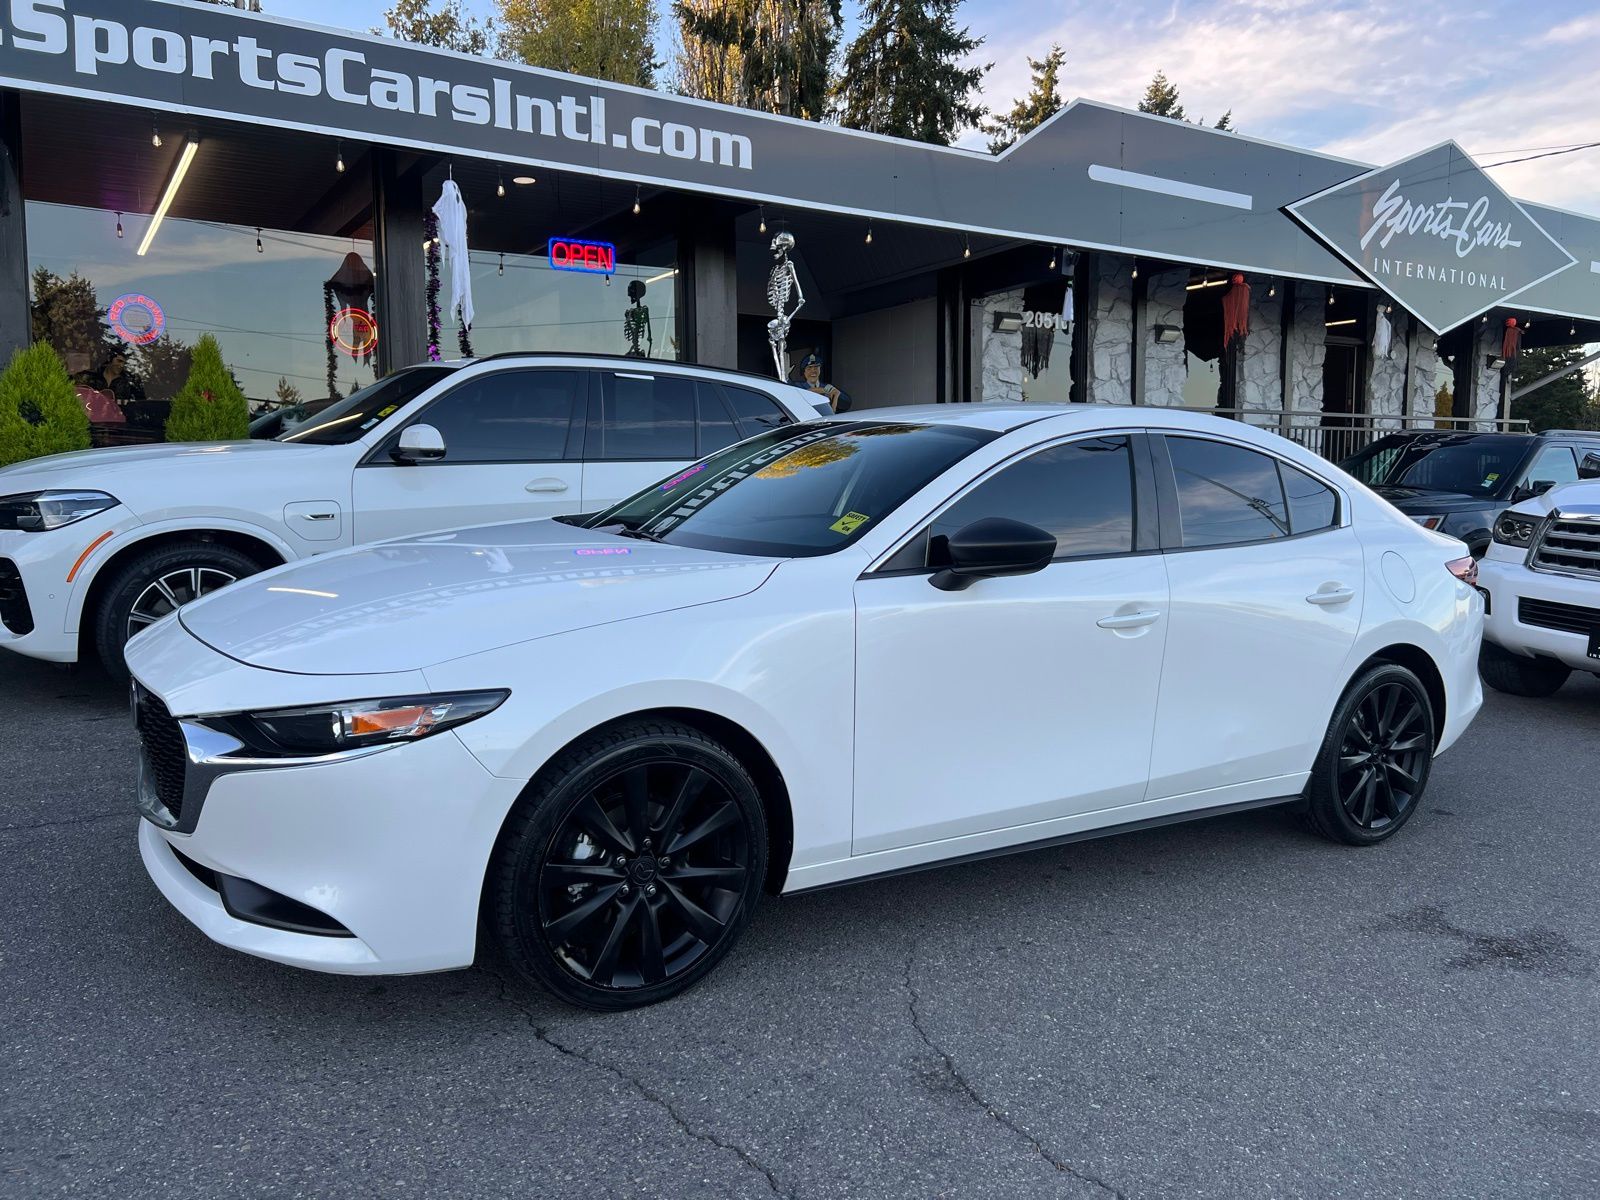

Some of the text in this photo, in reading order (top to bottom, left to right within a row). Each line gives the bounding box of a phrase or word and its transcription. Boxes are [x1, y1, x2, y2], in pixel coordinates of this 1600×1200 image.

[0, 0, 753, 170] SportsCarsIntl.com
[1360, 178, 1522, 258] Sports Cars
[552, 242, 613, 271] OPEN
[1373, 257, 1507, 291] INTERNATIONAL
[110, 299, 125, 321] RED
